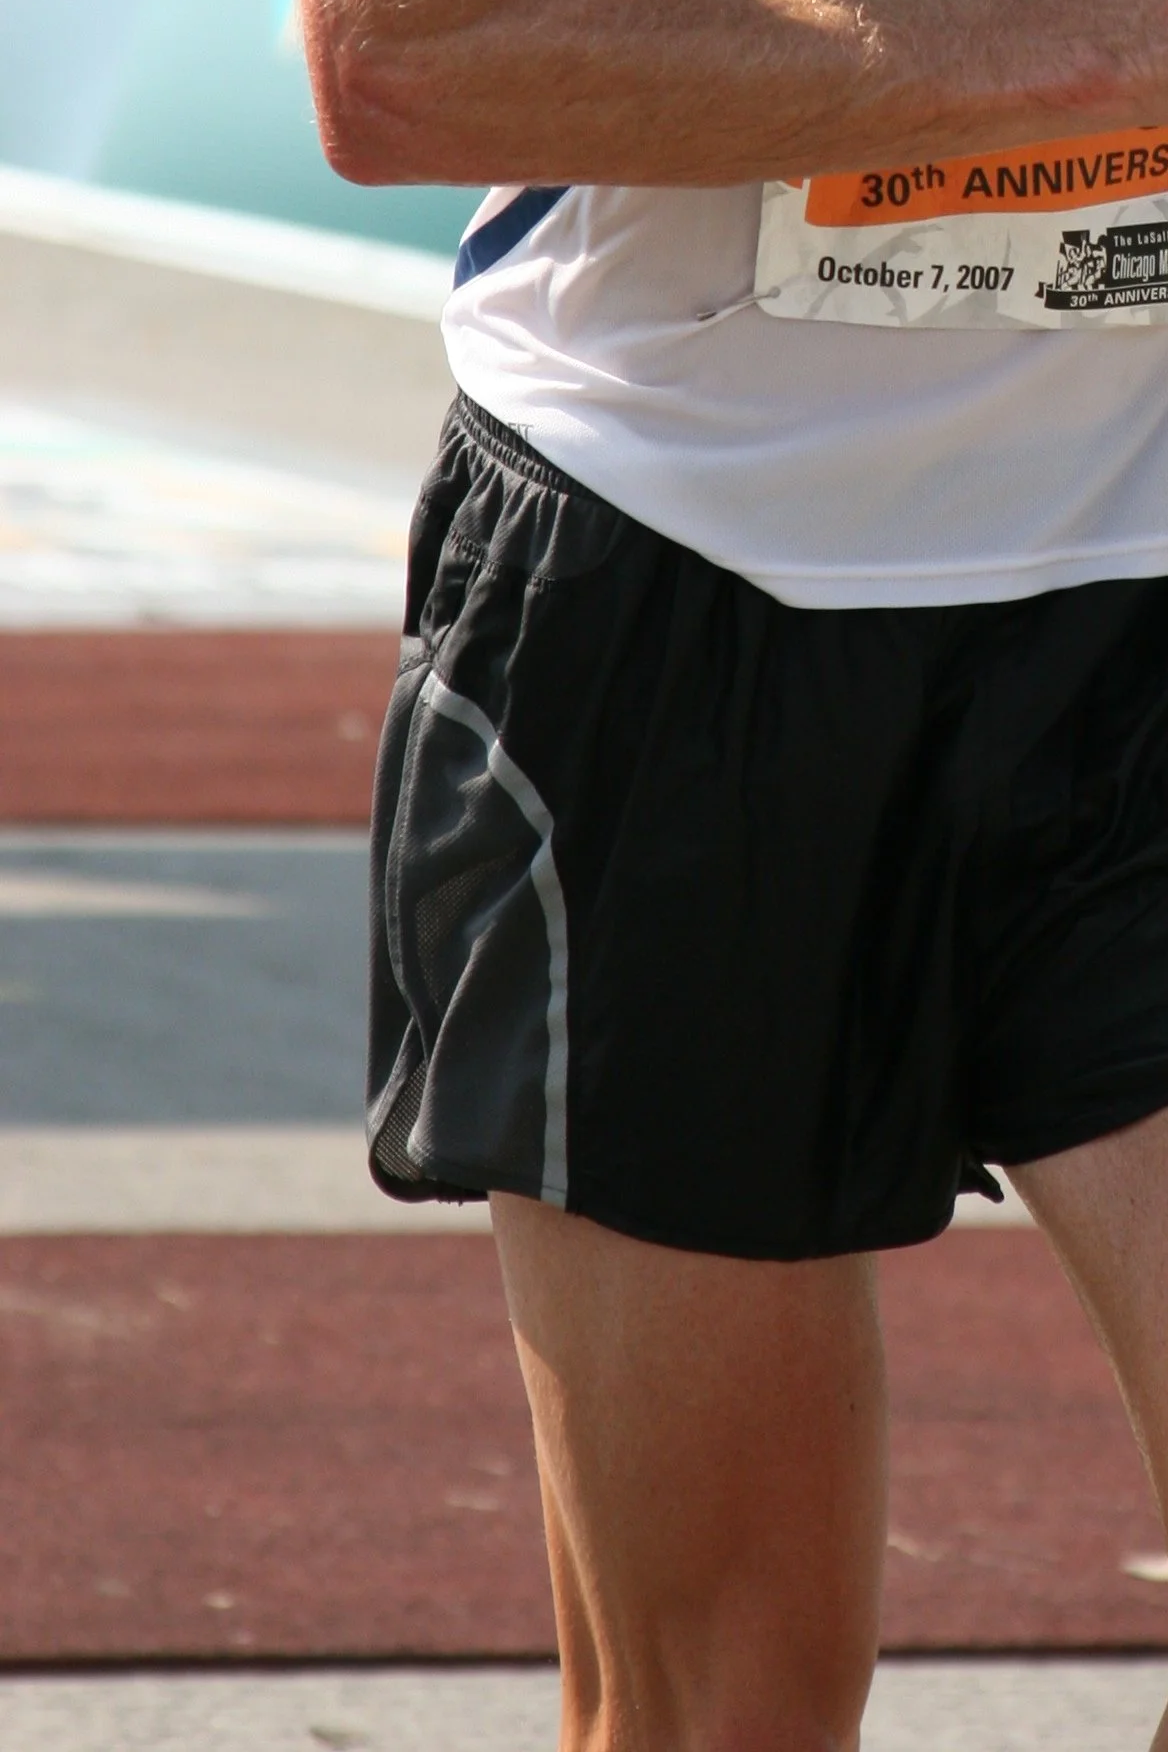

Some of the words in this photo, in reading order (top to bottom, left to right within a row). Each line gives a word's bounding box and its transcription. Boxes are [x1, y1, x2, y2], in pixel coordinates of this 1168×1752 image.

[861, 164, 945, 208] 30th
[1113, 234, 1132, 247] The
[818, 256, 923, 289] October
[931, 264, 949, 293] 7,
[957, 265, 1014, 292] 2007
[1112, 252, 1155, 282] Chicago
[1069, 293, 1098, 308] 30th
